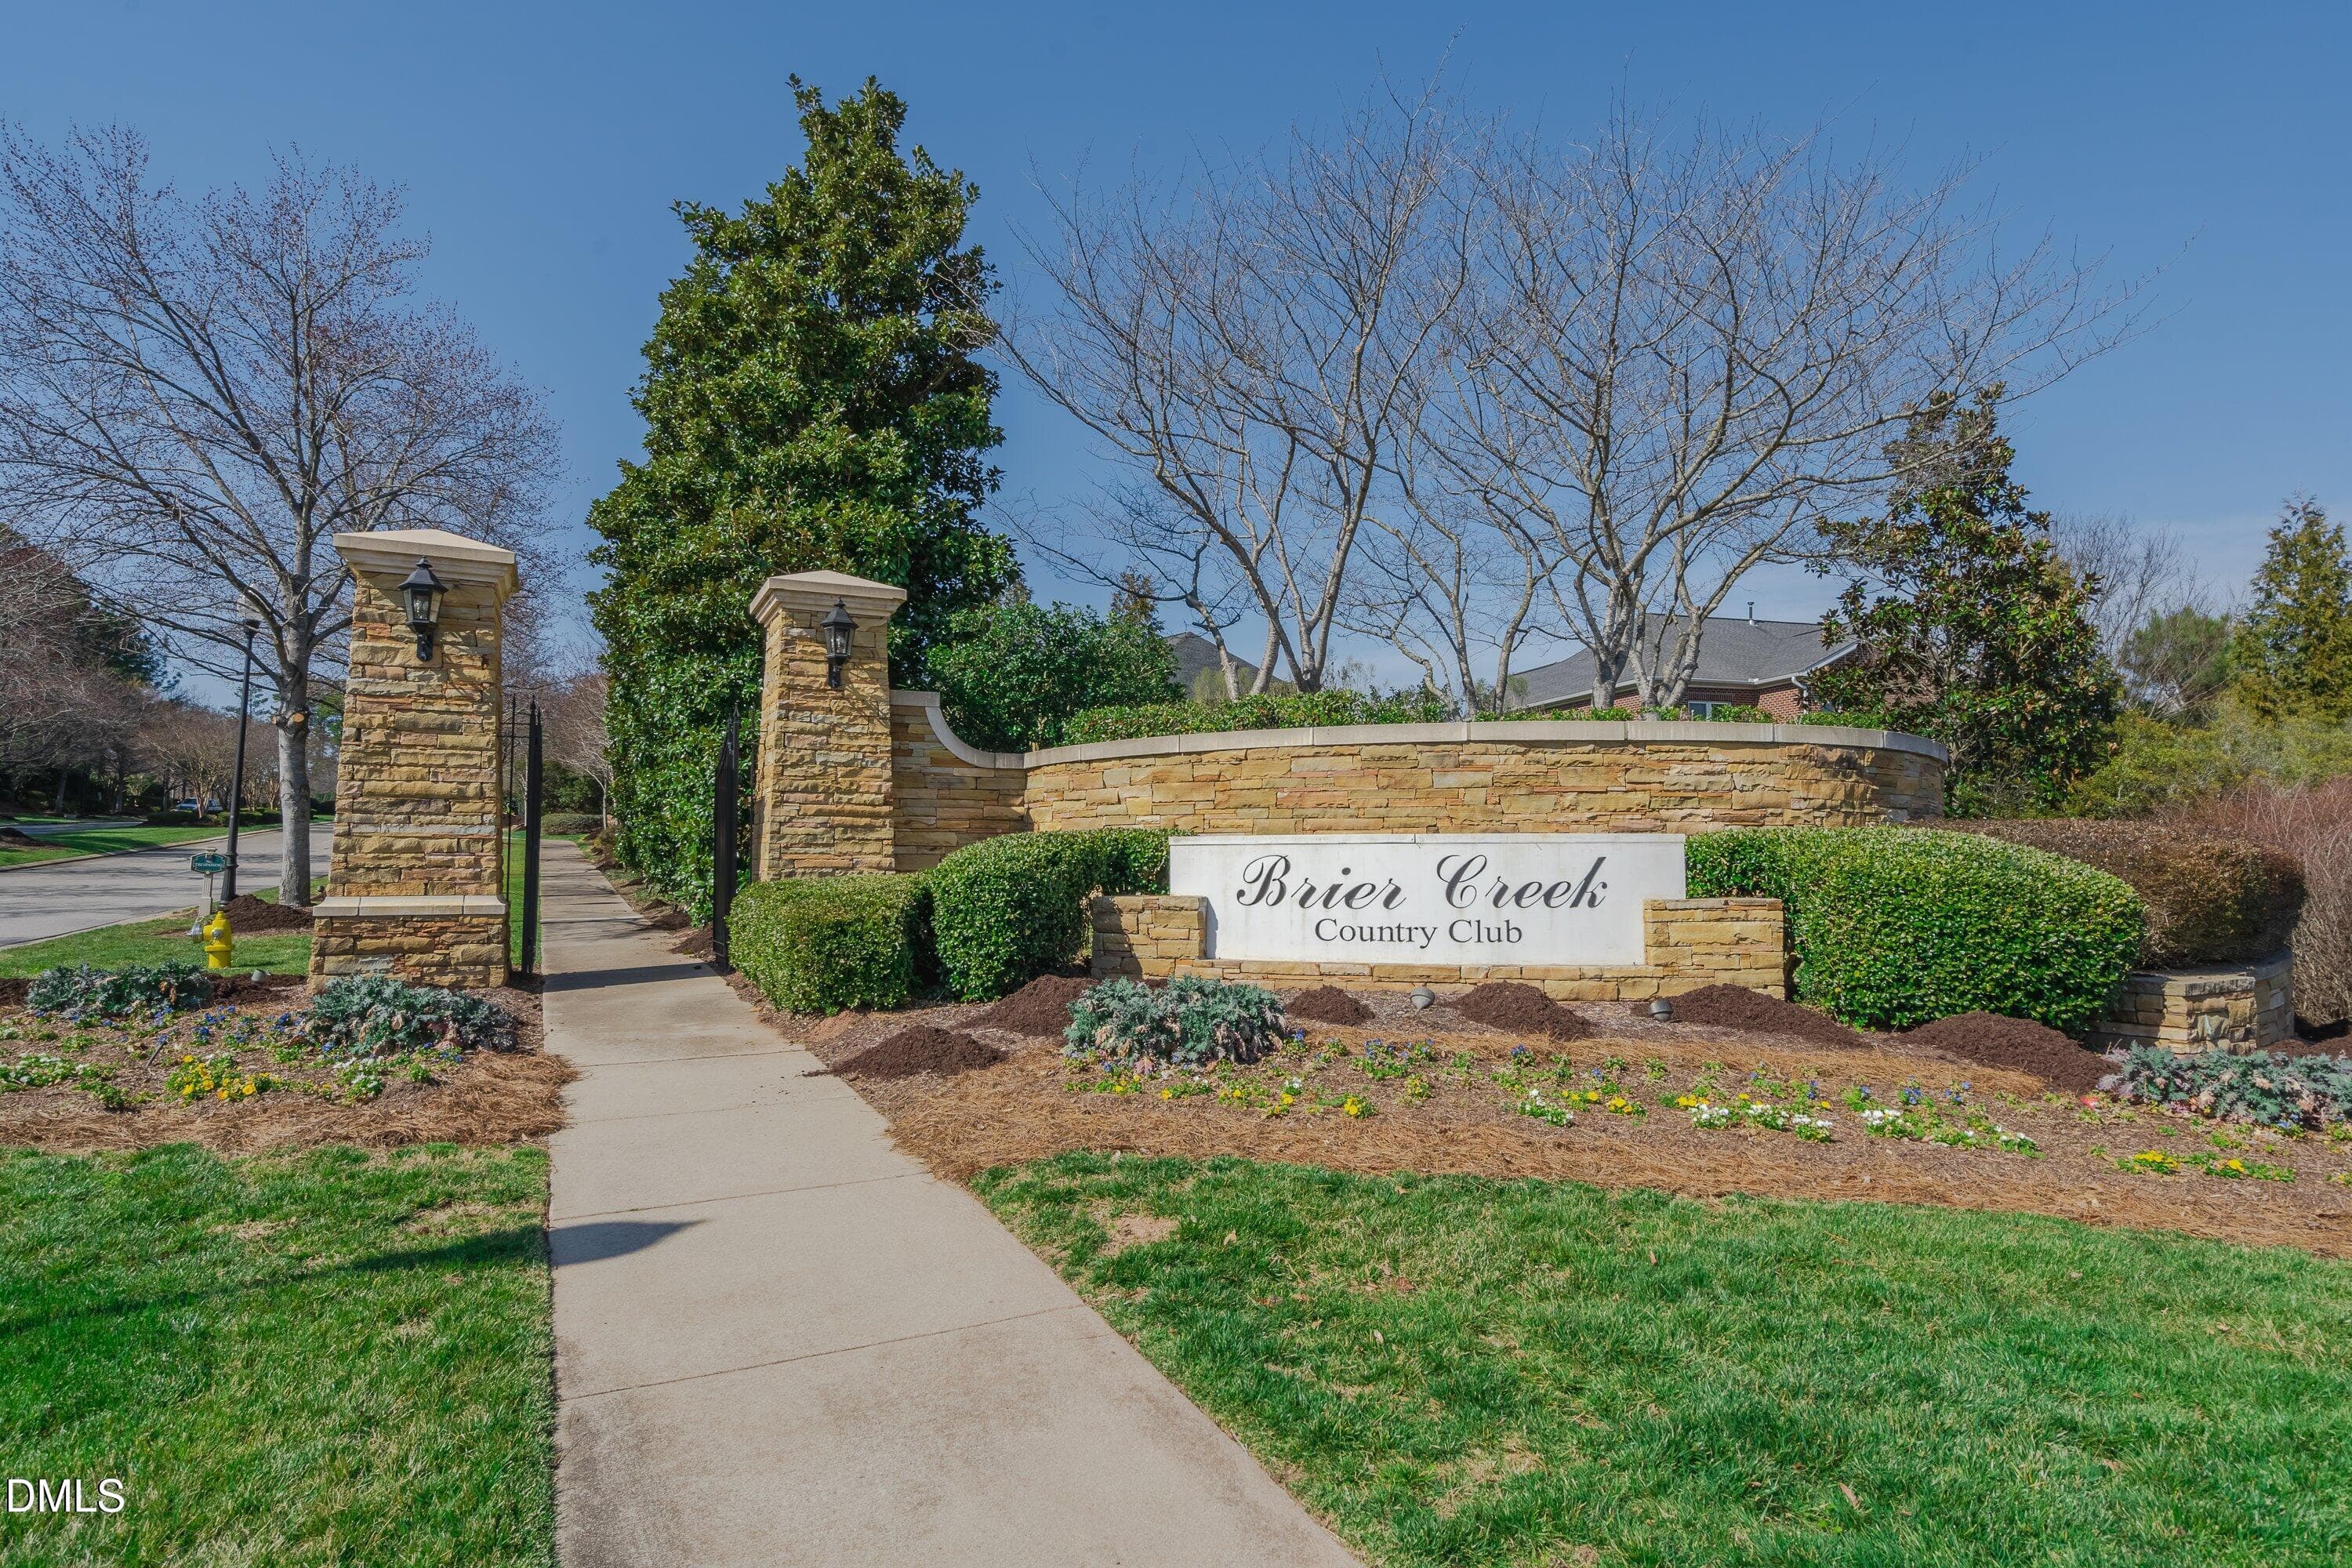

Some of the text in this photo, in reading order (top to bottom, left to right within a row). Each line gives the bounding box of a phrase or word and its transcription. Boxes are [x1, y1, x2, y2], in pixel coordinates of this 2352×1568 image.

[1236, 855, 1608, 909] Brier Creek
[1315, 918, 1523, 949] Country Club
